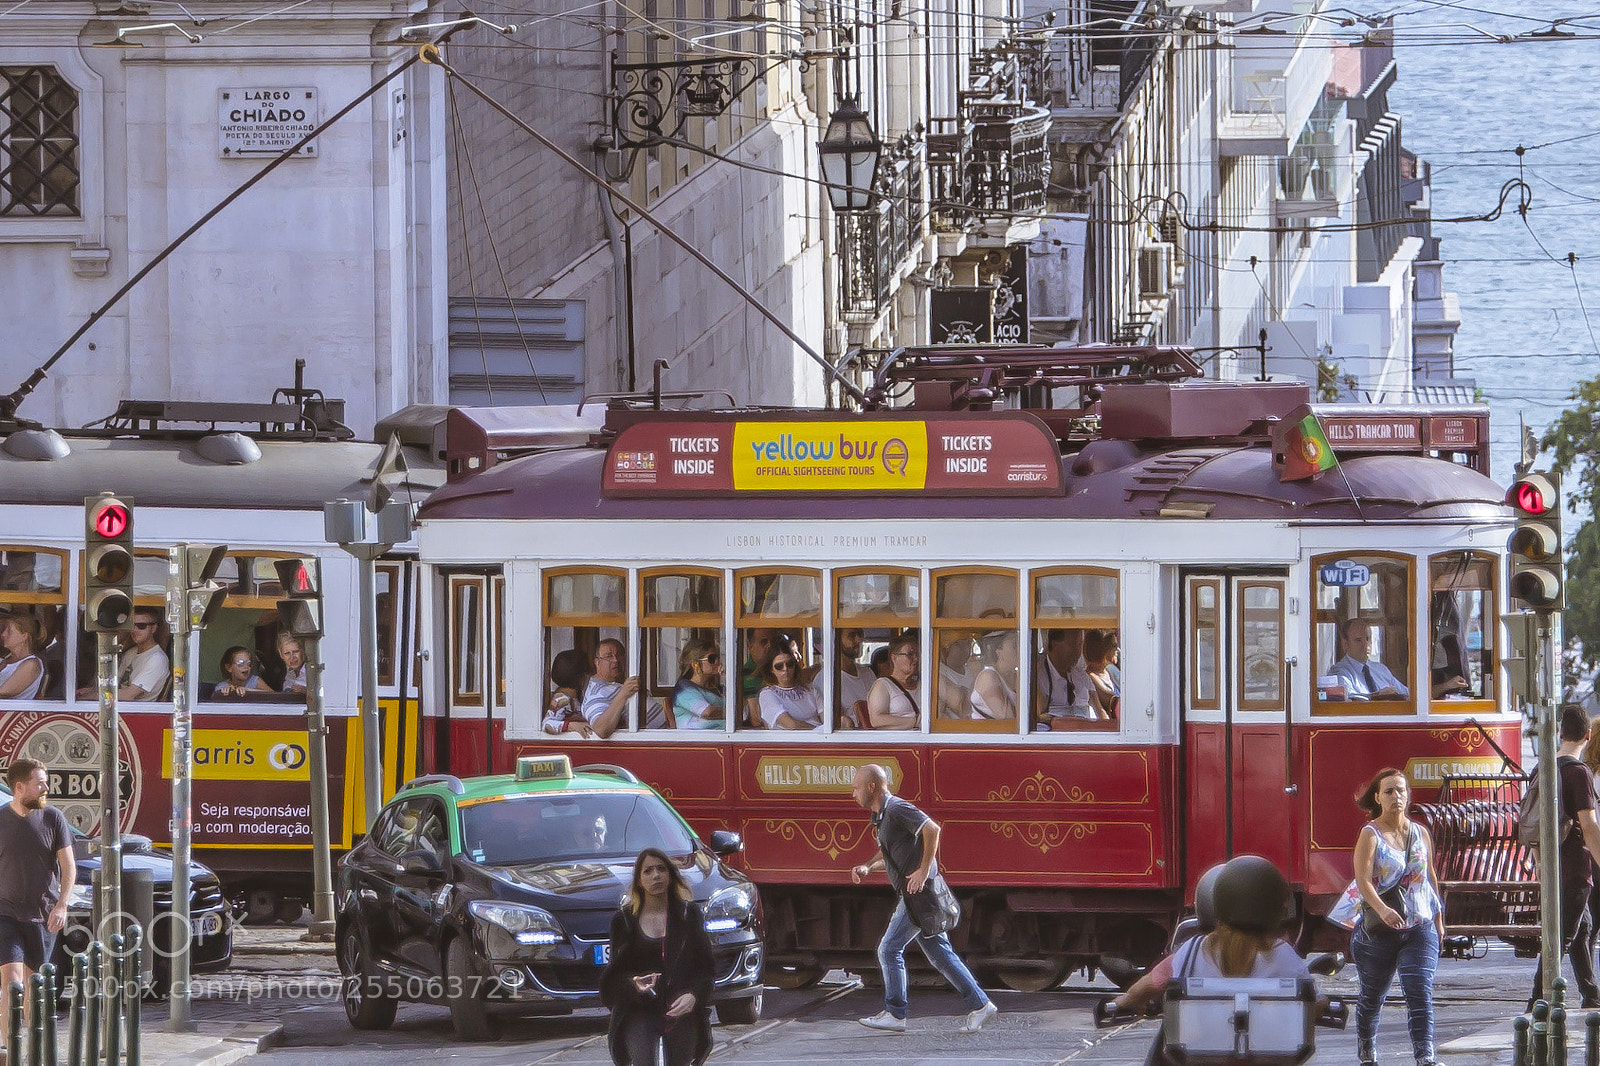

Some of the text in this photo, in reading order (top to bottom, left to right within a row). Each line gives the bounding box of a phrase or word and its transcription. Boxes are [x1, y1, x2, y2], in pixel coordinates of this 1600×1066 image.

[245, 91, 290, 100] LARGO
[230, 109, 306, 122] CHIADO
[1329, 424, 1416, 440] HILLS TRAMCAR TOUR
[669, 437, 720, 453] TICKETS
[751, 433, 878, 461] yellow bus
[941, 435, 992, 451] TICKETS
[674, 459, 715, 475] INSIDE
[756, 466, 875, 476] OFFICIAL SIGHTSEEING TOURS
[946, 458, 988, 473] INSIDE
[1007, 471, 1041, 481] carristur
[726, 535, 928, 547] LISBON HISTORICAL PREMIUM TRAMCAR
[193, 740, 255, 765] arris
[531, 762, 554, 773] TAXI
[764, 765, 801, 785] HILLS
[1413, 763, 1448, 780] HILLS
[200, 802, 310, 819] Seja responsável
[206, 822, 234, 833] com
[238, 819, 314, 838] moderação.
